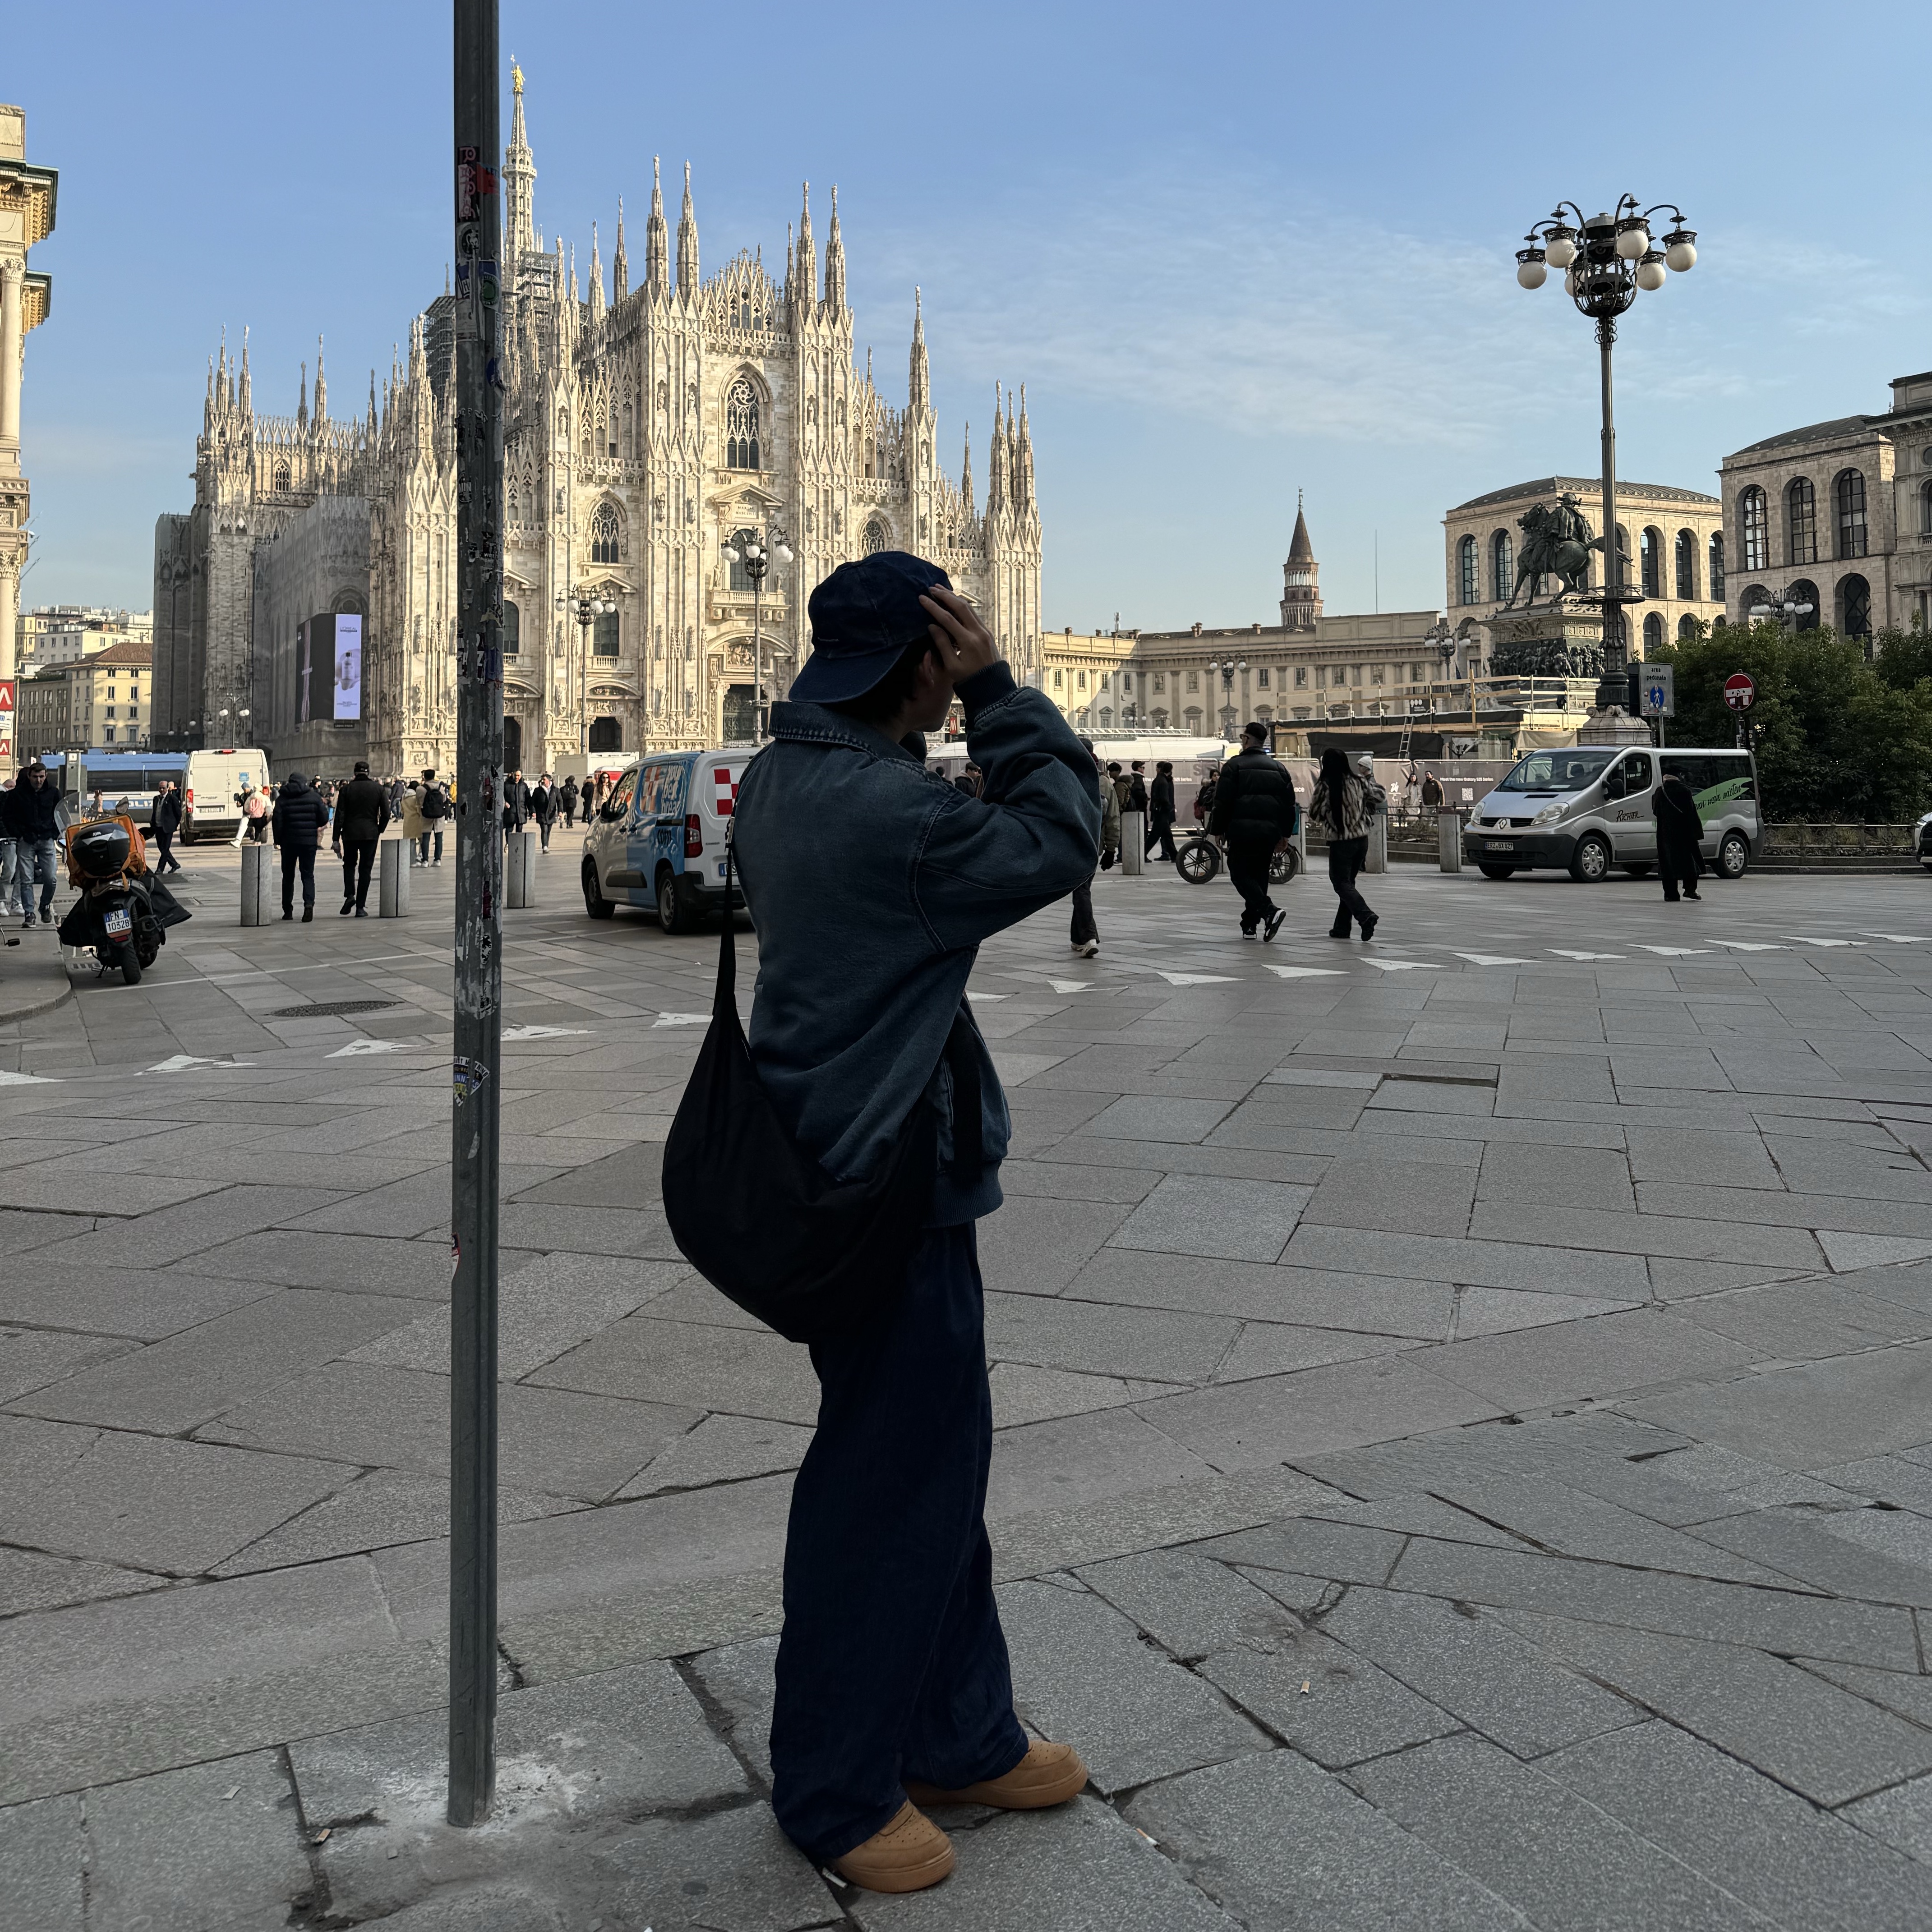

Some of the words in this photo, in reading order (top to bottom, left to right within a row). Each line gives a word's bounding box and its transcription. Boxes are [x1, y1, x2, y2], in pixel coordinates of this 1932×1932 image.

[950, 719, 956, 731] M
[1723, 783, 1741, 800] mieten
[110, 911, 120, 920] FN
[108, 919, 129, 931] 10328
